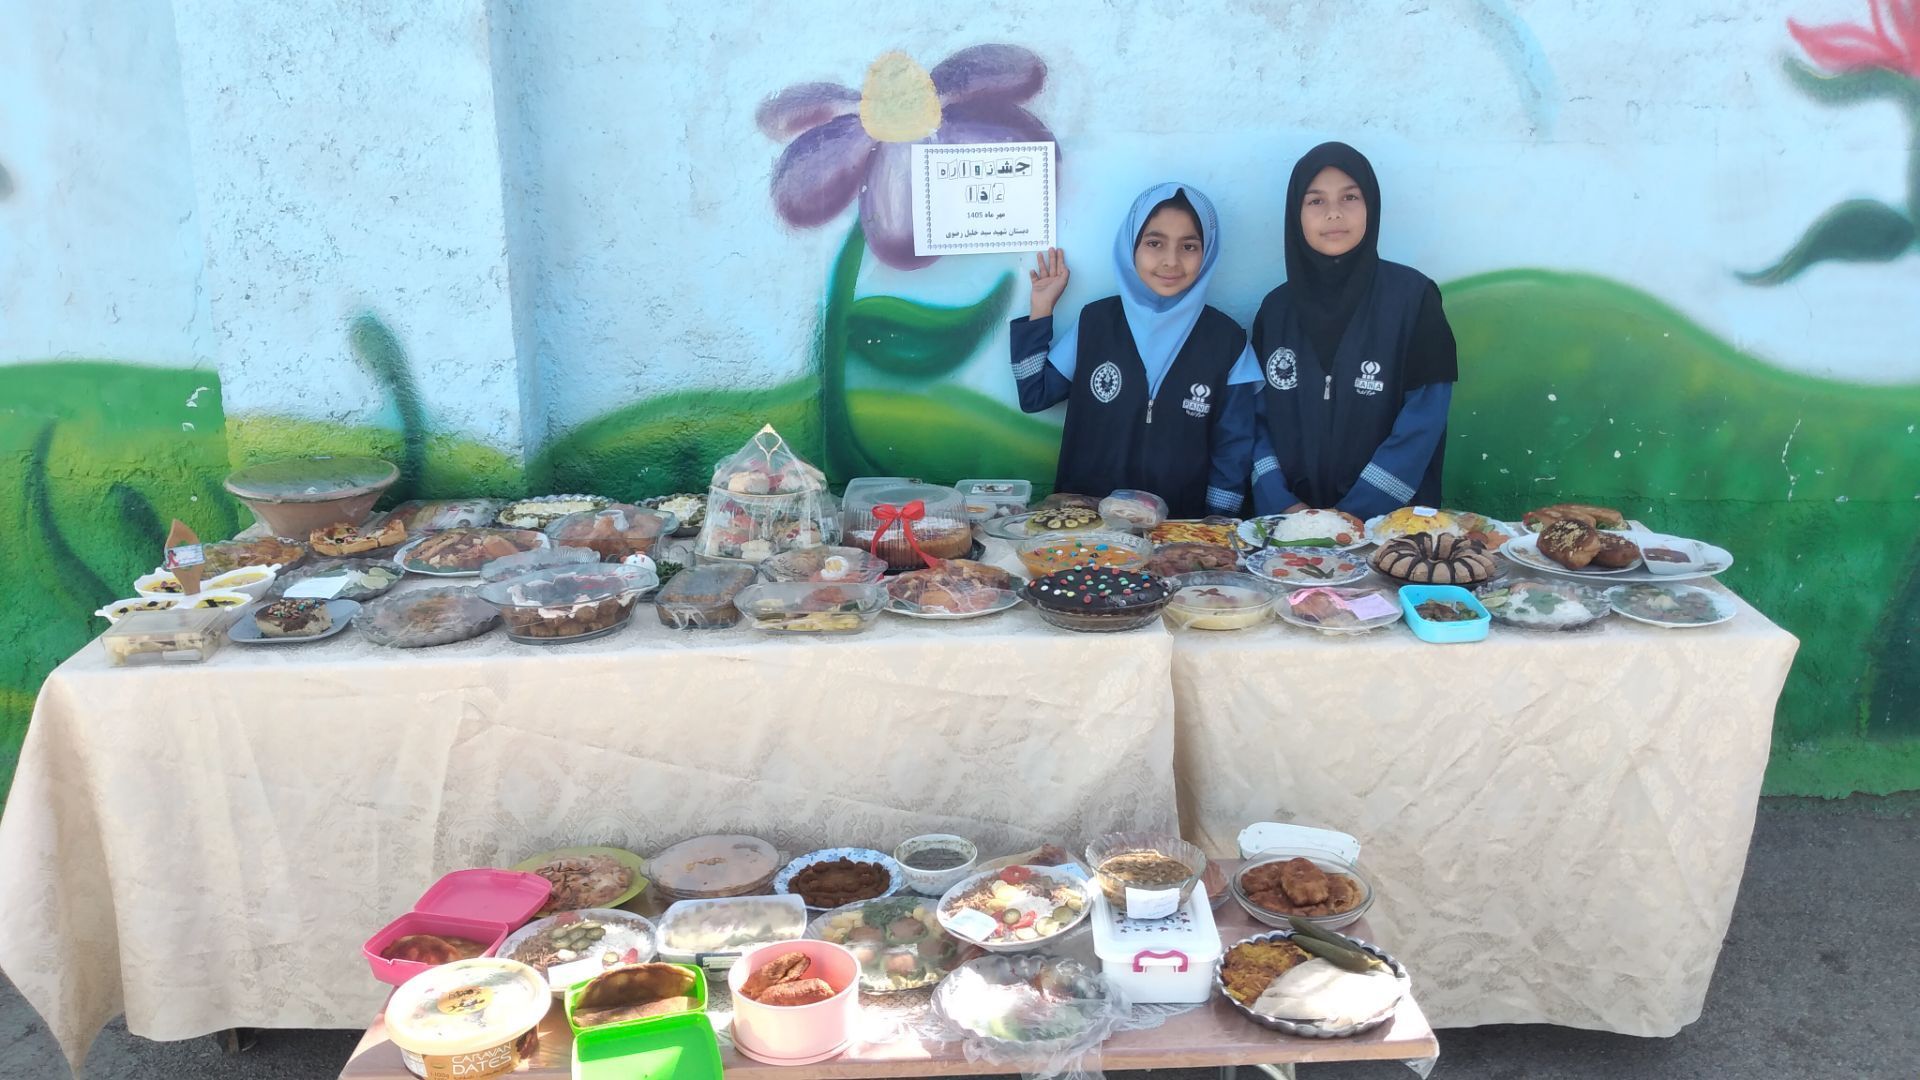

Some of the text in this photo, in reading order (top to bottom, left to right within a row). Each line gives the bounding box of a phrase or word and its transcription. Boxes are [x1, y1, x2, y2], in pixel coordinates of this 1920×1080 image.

[969, 183, 1003, 201] غذا
[967, 210, 1006, 220] مهر ماه 1405
[964, 228, 978, 238] خلیل
[992, 227, 1007, 236] شهید
[1008, 227, 1029, 236] دبستان
[452, 1041, 512, 1064] CARAVAN
[452, 1051, 512, 1075] DATES
